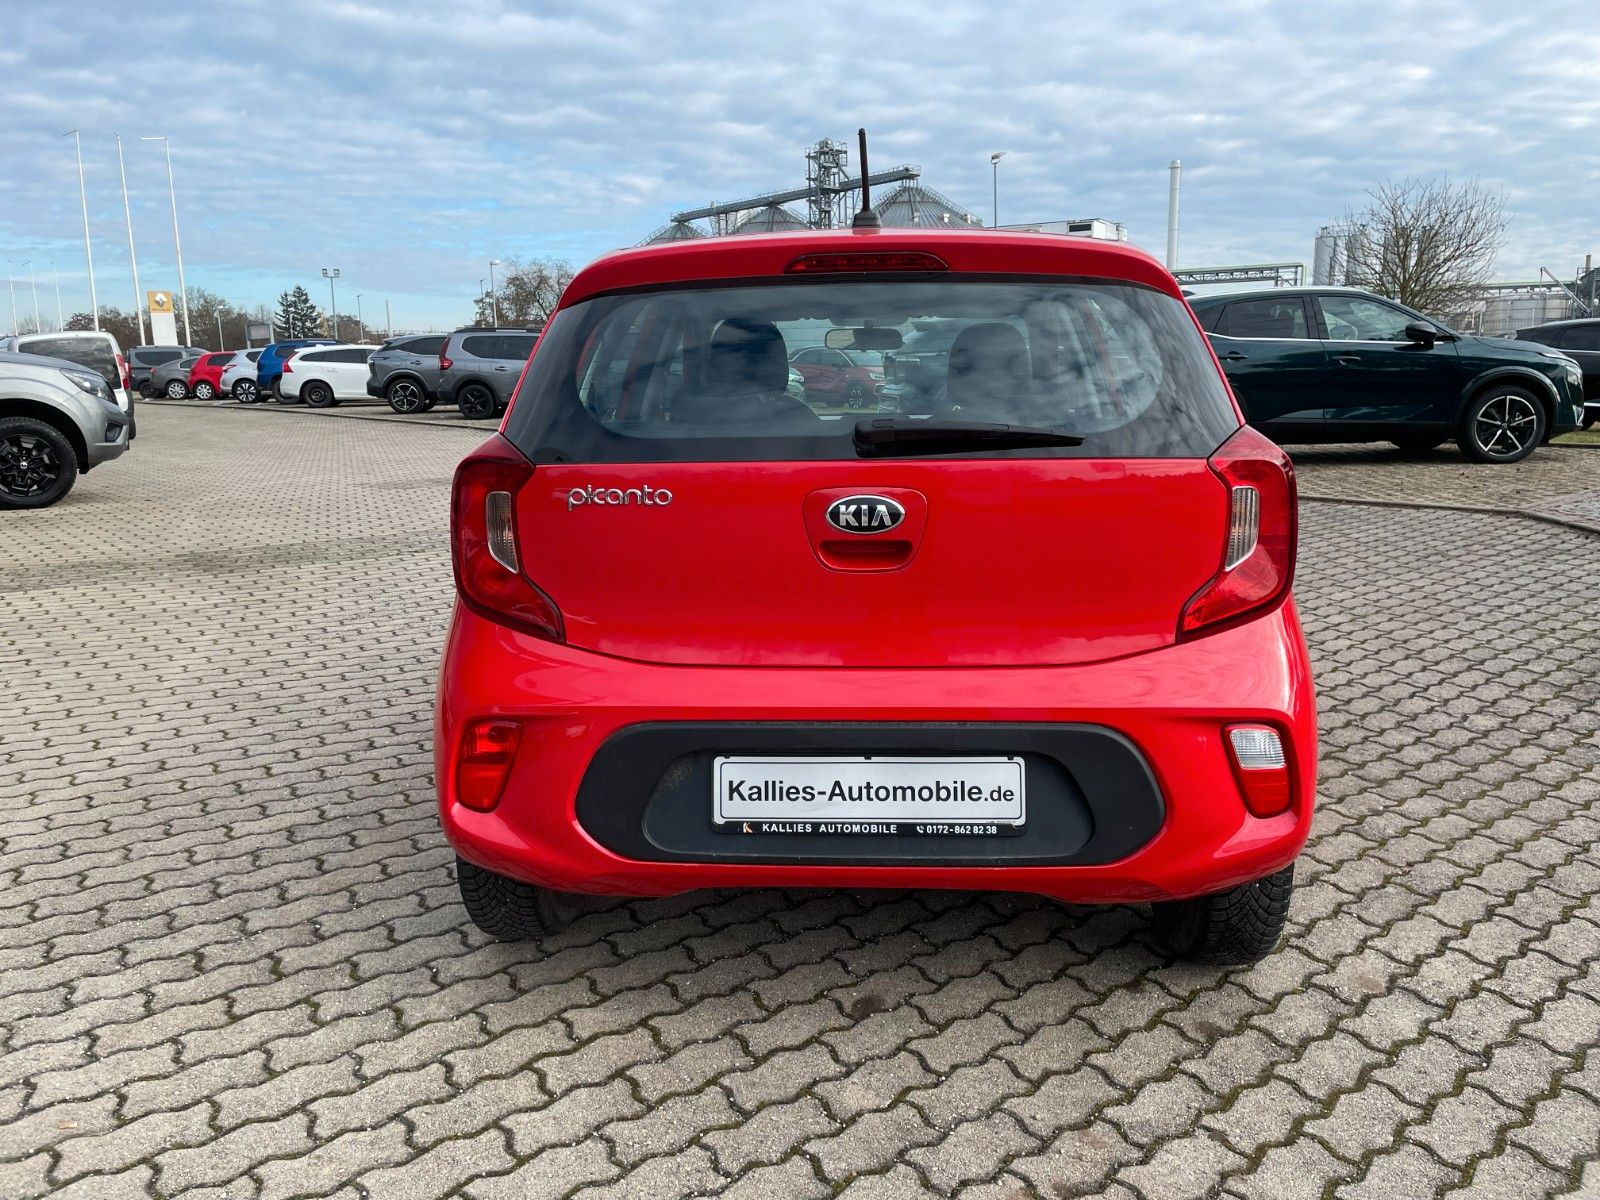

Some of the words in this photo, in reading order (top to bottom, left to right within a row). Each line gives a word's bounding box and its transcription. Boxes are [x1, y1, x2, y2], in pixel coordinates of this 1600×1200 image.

[567, 484, 673, 512] picanto
[838, 504, 892, 527] KIA
[728, 780, 1014, 802] Kallies-Automobile.de
[762, 823, 812, 833] KALLIES
[819, 824, 898, 834] AUTOMOBILE
